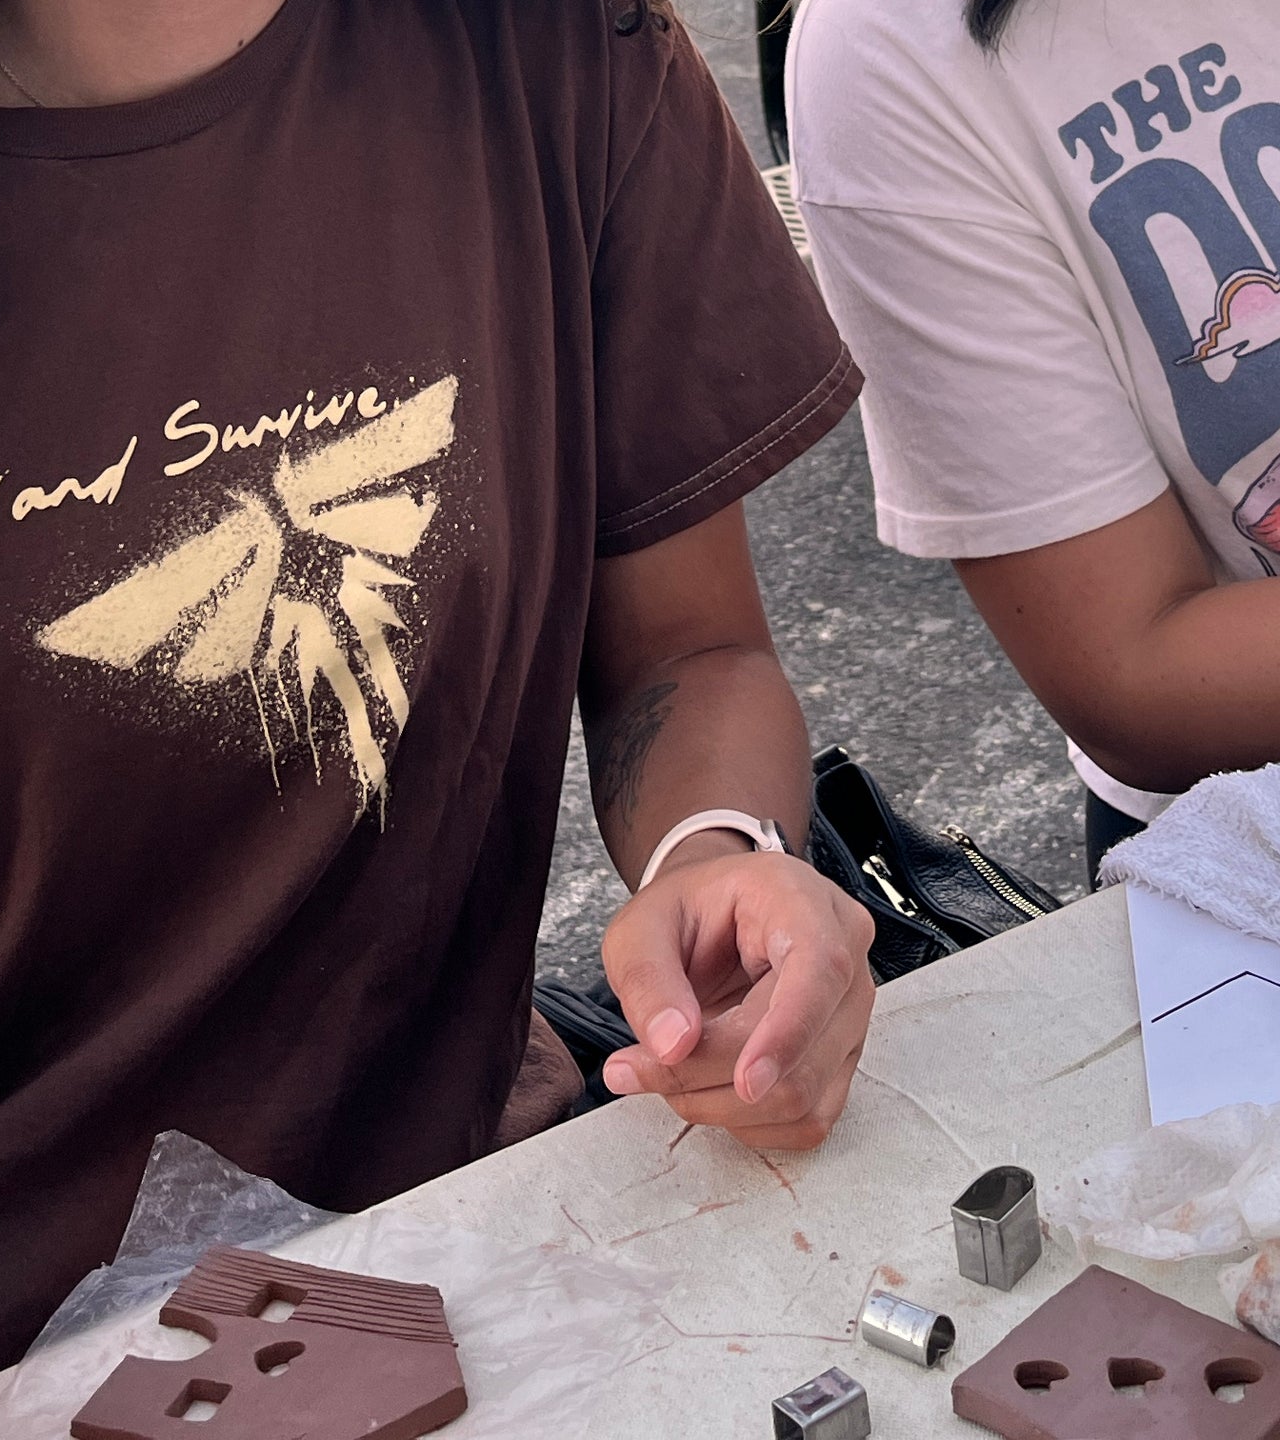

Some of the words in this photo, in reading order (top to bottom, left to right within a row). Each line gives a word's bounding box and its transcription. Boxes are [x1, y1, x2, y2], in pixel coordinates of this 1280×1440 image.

[1059, 43, 1242, 185] THE
[11, 435, 138, 521] and
[163, 386, 387, 477] Survive
